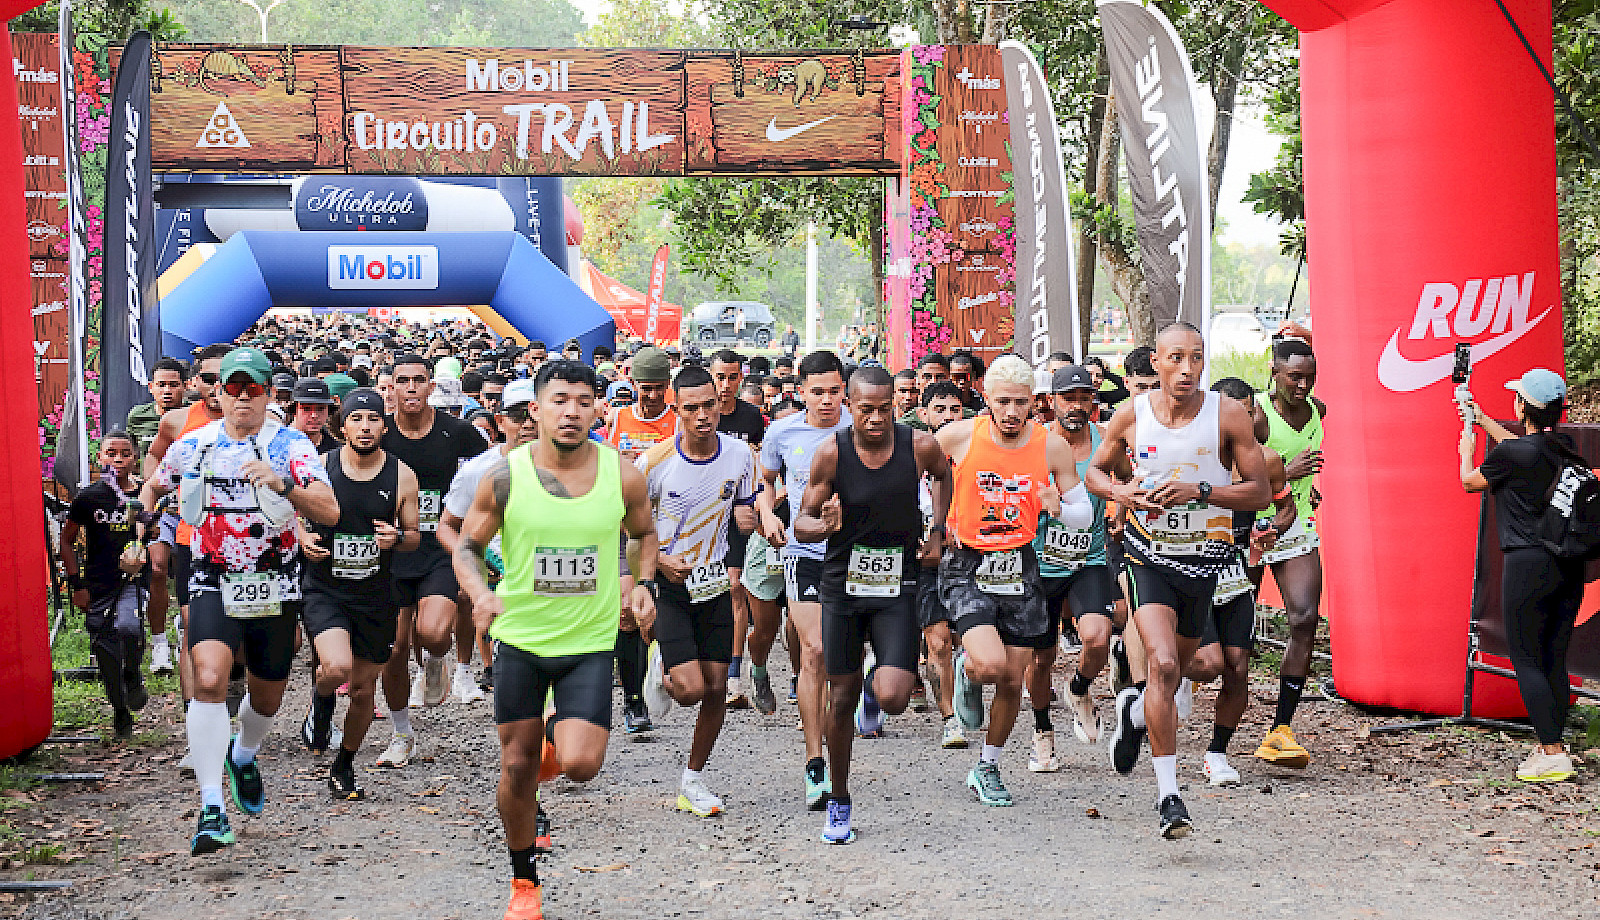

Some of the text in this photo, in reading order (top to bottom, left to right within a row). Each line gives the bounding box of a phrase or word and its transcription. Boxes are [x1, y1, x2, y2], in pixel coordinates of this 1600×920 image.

[466, 58, 570, 92] Mobil
[354, 99, 677, 162] Circuito TRAIL
[307, 184, 415, 215] Michelob
[328, 213, 398, 225] ULTRA
[125, 100, 148, 386] SPORTLINE
[338, 254, 424, 281] Mobil
[1407, 270, 1536, 340] RUN
[1167, 512, 1191, 530] 61
[1049, 530, 1091, 550] 1049
[537, 556, 595, 576] 1113
[857, 556, 894, 573] 563
[231, 583, 271, 602] 299
